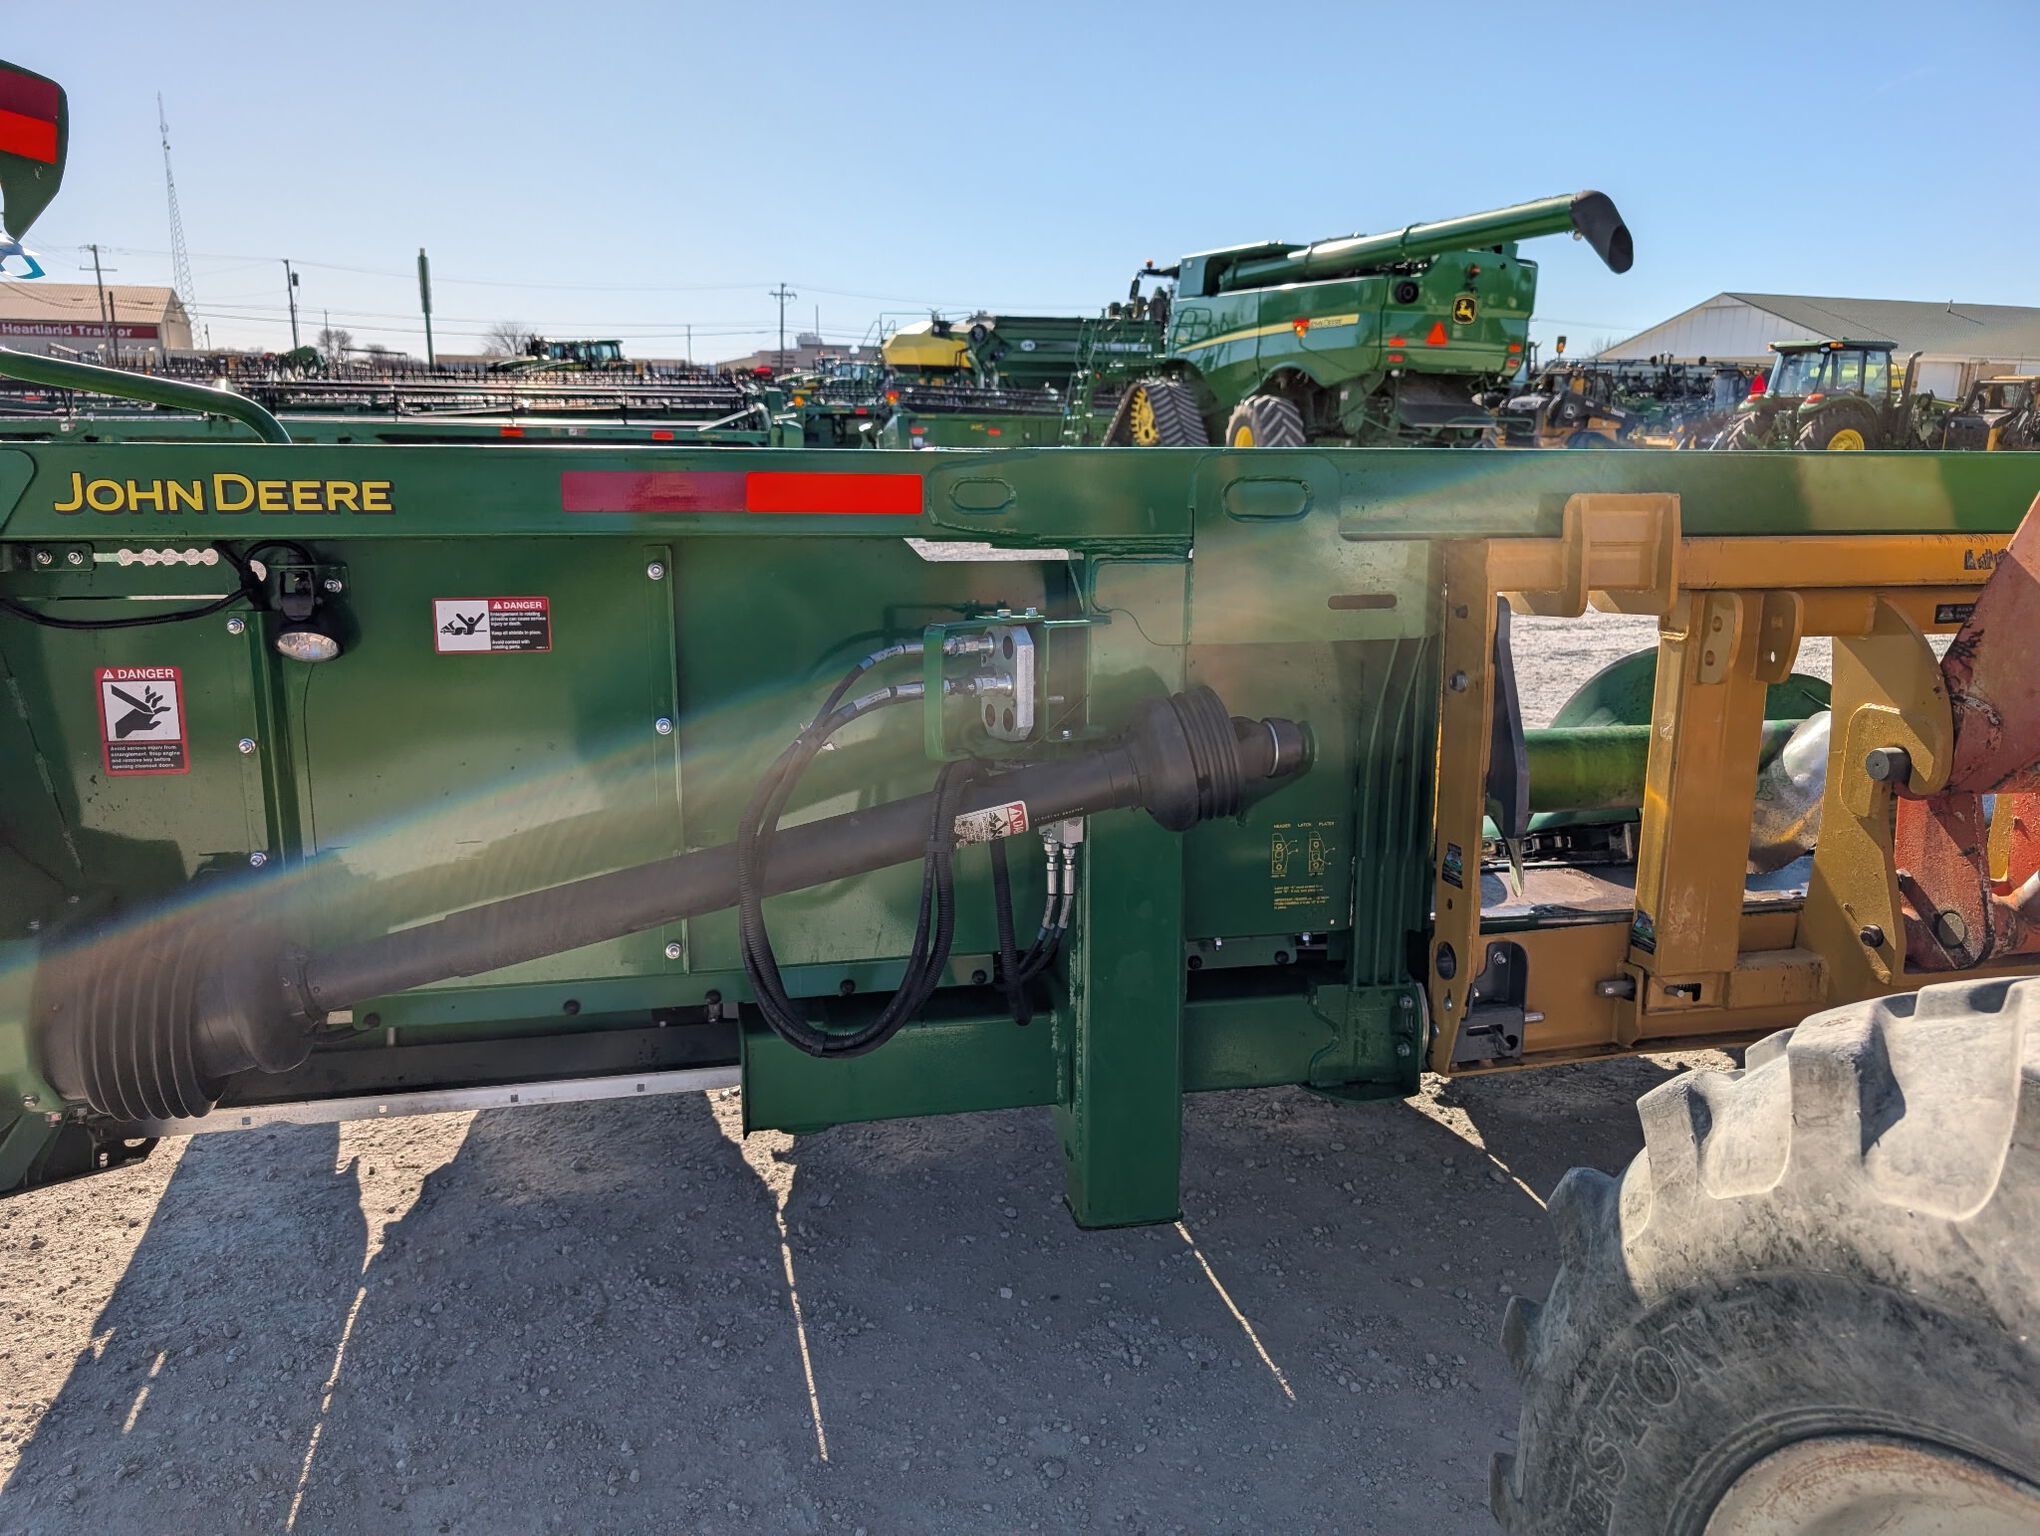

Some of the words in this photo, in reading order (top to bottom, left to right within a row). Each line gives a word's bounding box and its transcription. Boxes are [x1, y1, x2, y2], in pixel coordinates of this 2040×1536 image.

[2, 323, 72, 336] Heartland
[54, 472, 206, 514] JOHN
[212, 472, 395, 514] DEERE
[503, 601, 542, 609] DANGER
[117, 668, 174, 679] DANGER
